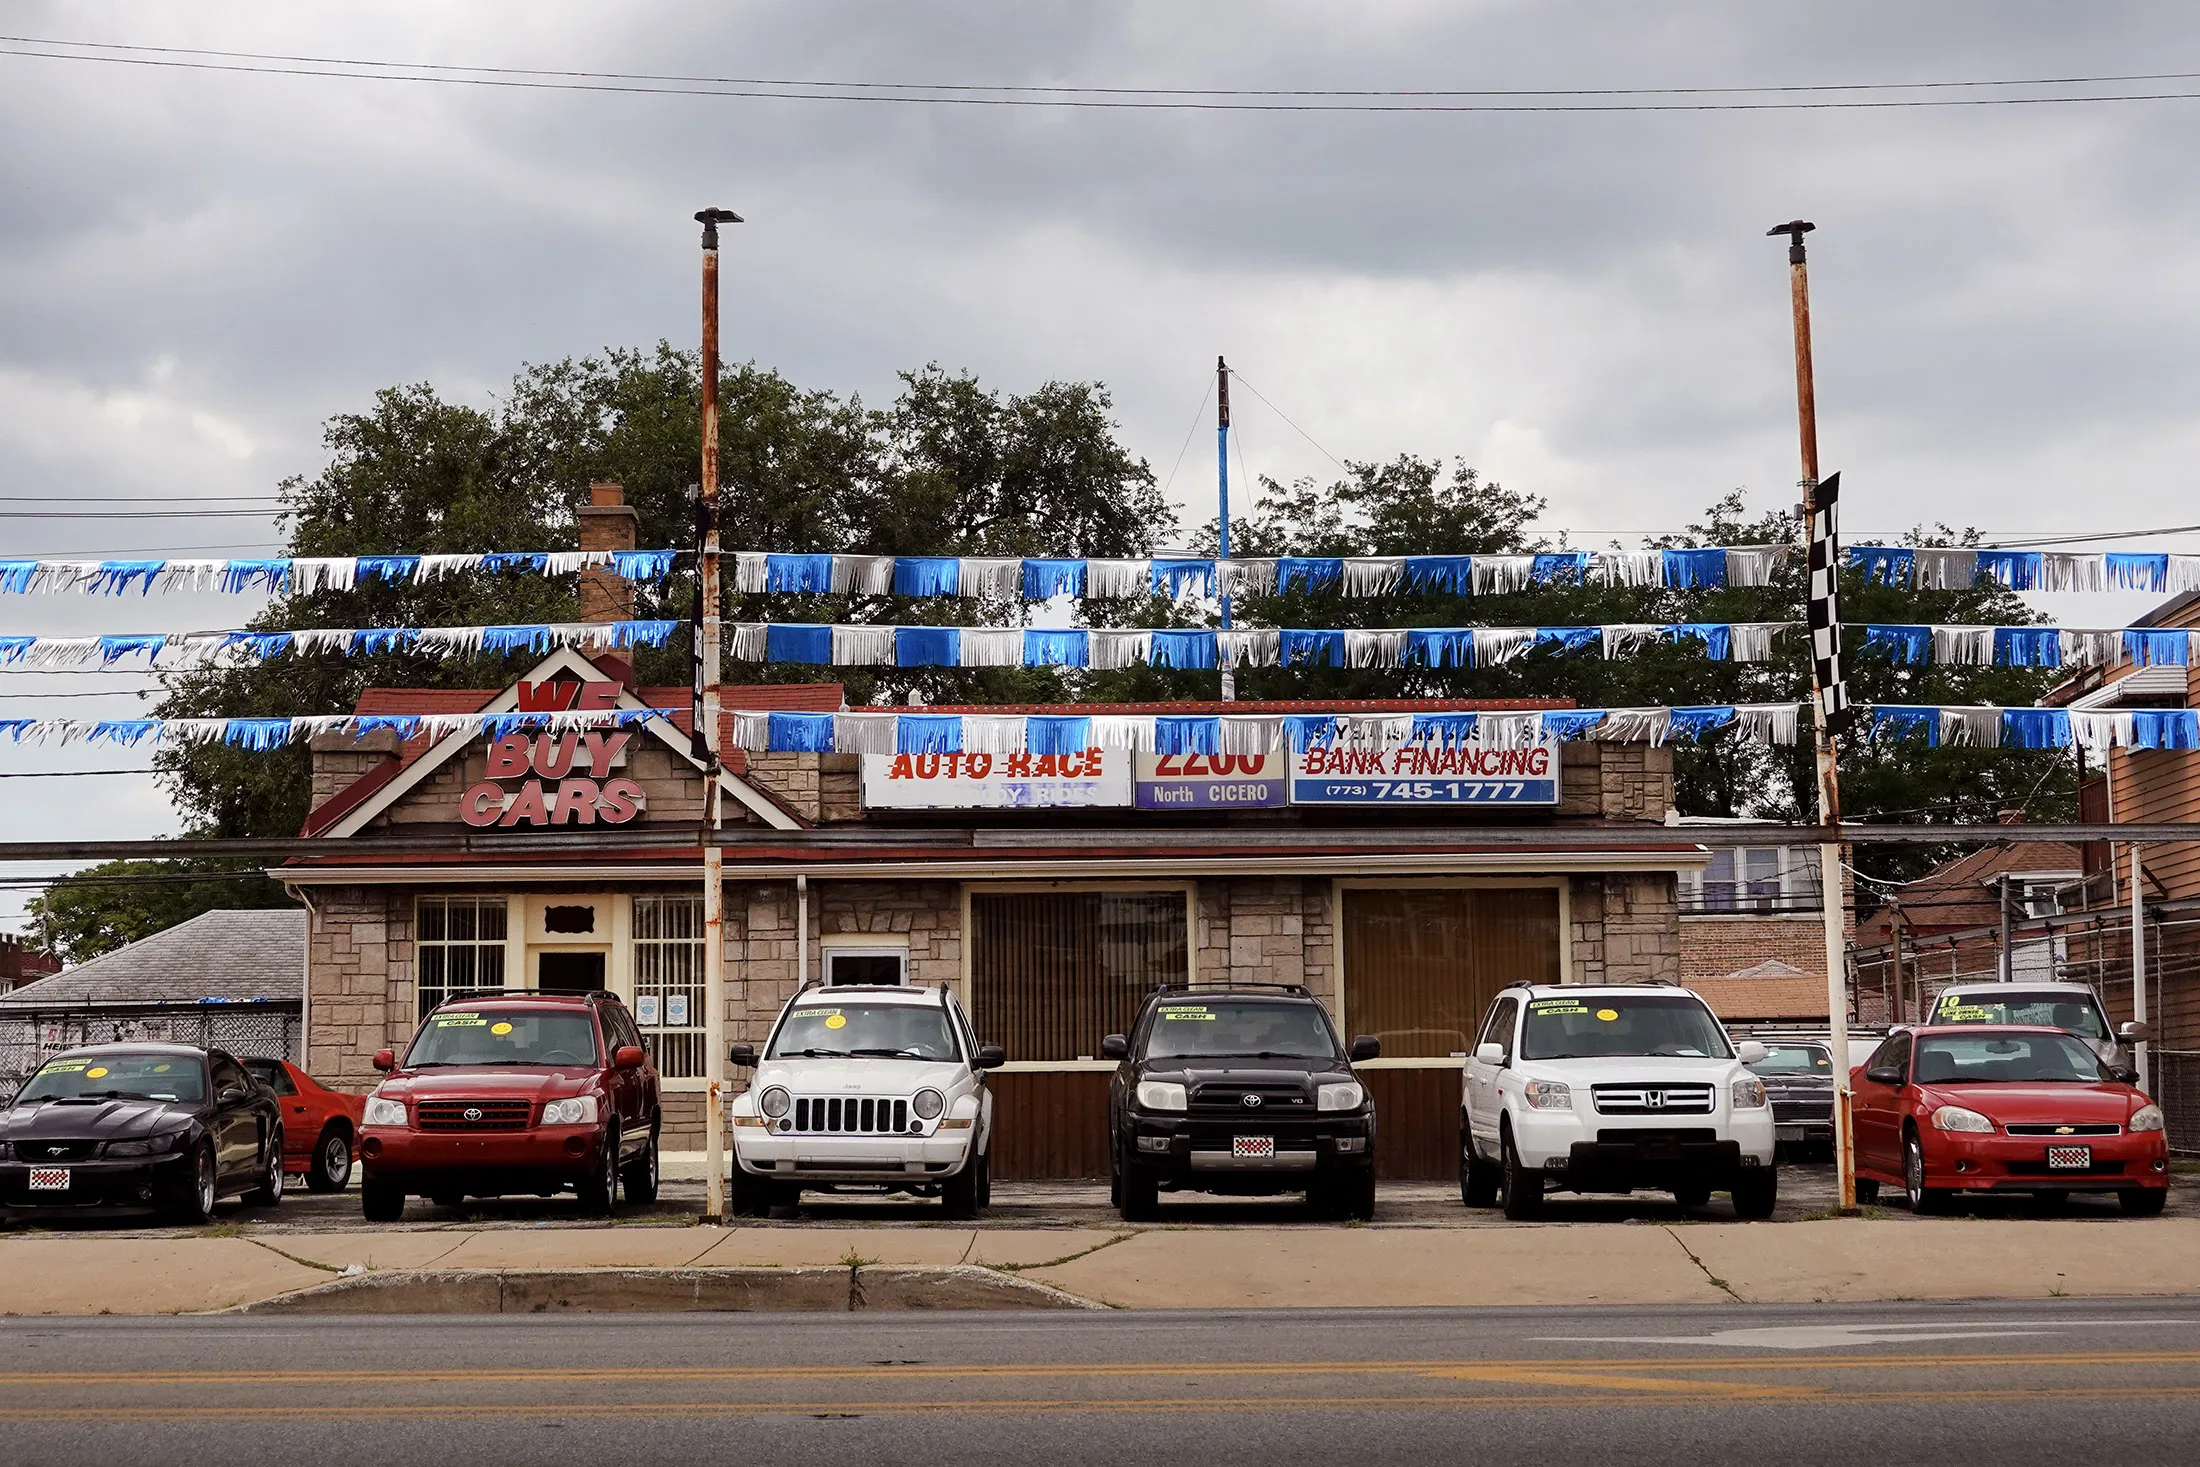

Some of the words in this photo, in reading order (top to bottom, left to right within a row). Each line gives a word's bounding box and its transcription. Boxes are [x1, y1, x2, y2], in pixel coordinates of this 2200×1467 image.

[517, 681, 623, 727] WE
[484, 731, 633, 780] BUY
[885, 750, 993, 779] AUTO
[1003, 747, 1104, 778] RACE
[1302, 747, 1387, 775] BANK
[1393, 746, 1550, 777] FINANCING
[459, 777, 646, 827] CARS
[1154, 785, 1194, 802] North
[1208, 784, 1268, 802] CICERO
[1325, 784, 1367, 797] (773)
[1372, 782, 1525, 801] 745-1777
[1940, 995, 1960, 1008] 10
